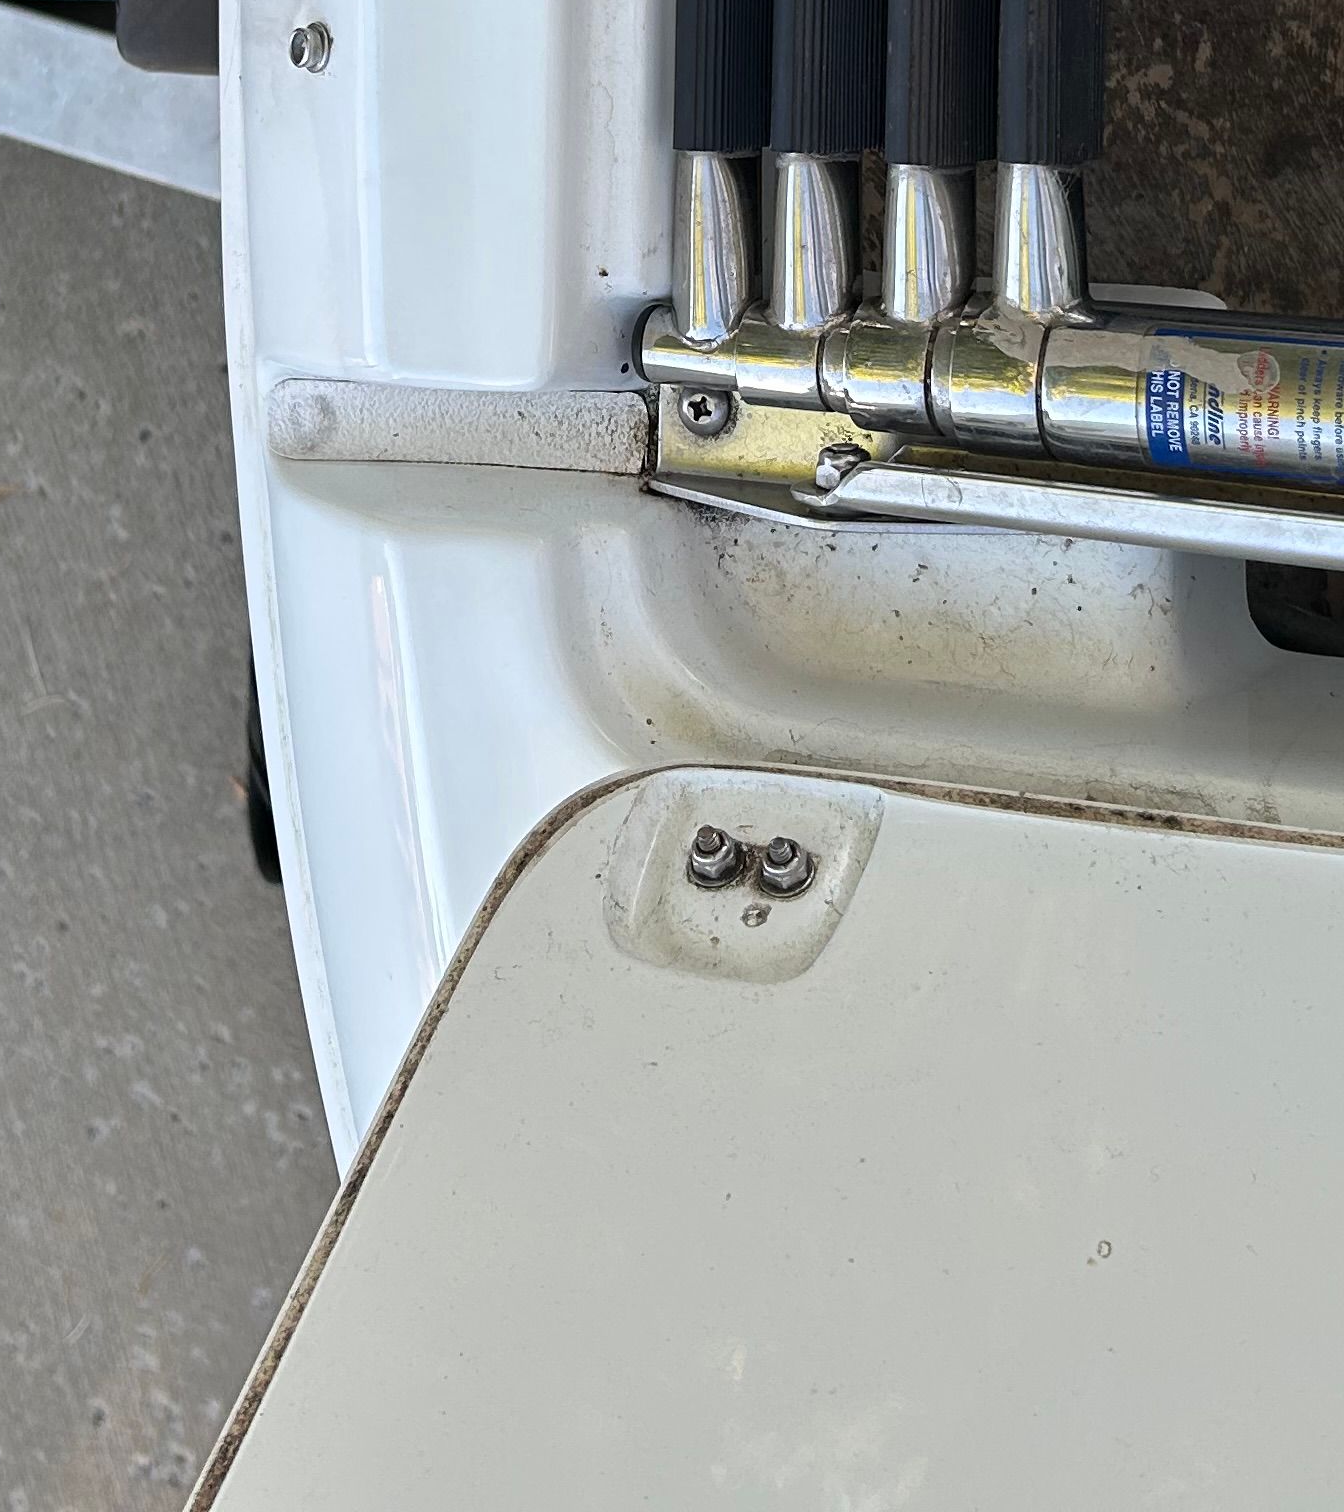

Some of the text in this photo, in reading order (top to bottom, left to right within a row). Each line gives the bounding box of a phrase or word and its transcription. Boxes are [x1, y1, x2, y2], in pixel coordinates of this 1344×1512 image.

[1298, 384, 1307, 395] of
[1150, 396, 1164, 438] LABEL
[1166, 371, 1183, 452] NOT REMOVE
[1189, 405, 1199, 418] CA
[1207, 385, 1224, 445] ndline
[1236, 399, 1252, 452] improperly
[1252, 411, 1262, 441] cause
[1267, 384, 1281, 440] WARNING!
[1295, 398, 1307, 428] pinch
[1310, 359, 1327, 461] Always keep fingers
[1334, 411, 1344, 445] before
[1295, 430, 1308, 460] points
